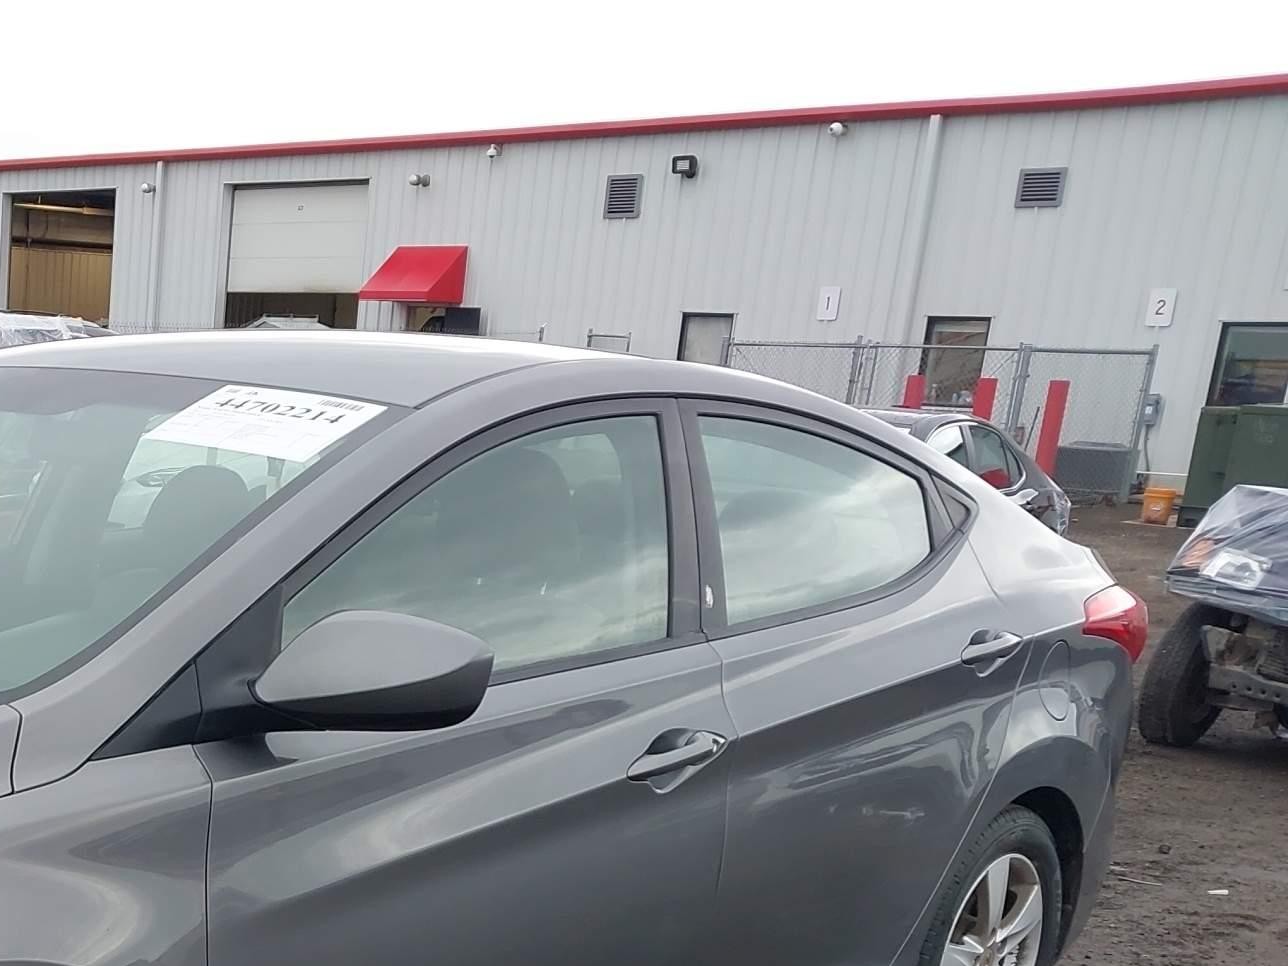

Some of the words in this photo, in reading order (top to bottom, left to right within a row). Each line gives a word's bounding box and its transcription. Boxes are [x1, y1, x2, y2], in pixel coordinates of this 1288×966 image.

[825, 296, 831, 311] 1
[1155, 299, 1166, 316] 2
[215, 397, 347, 424] 44702214
